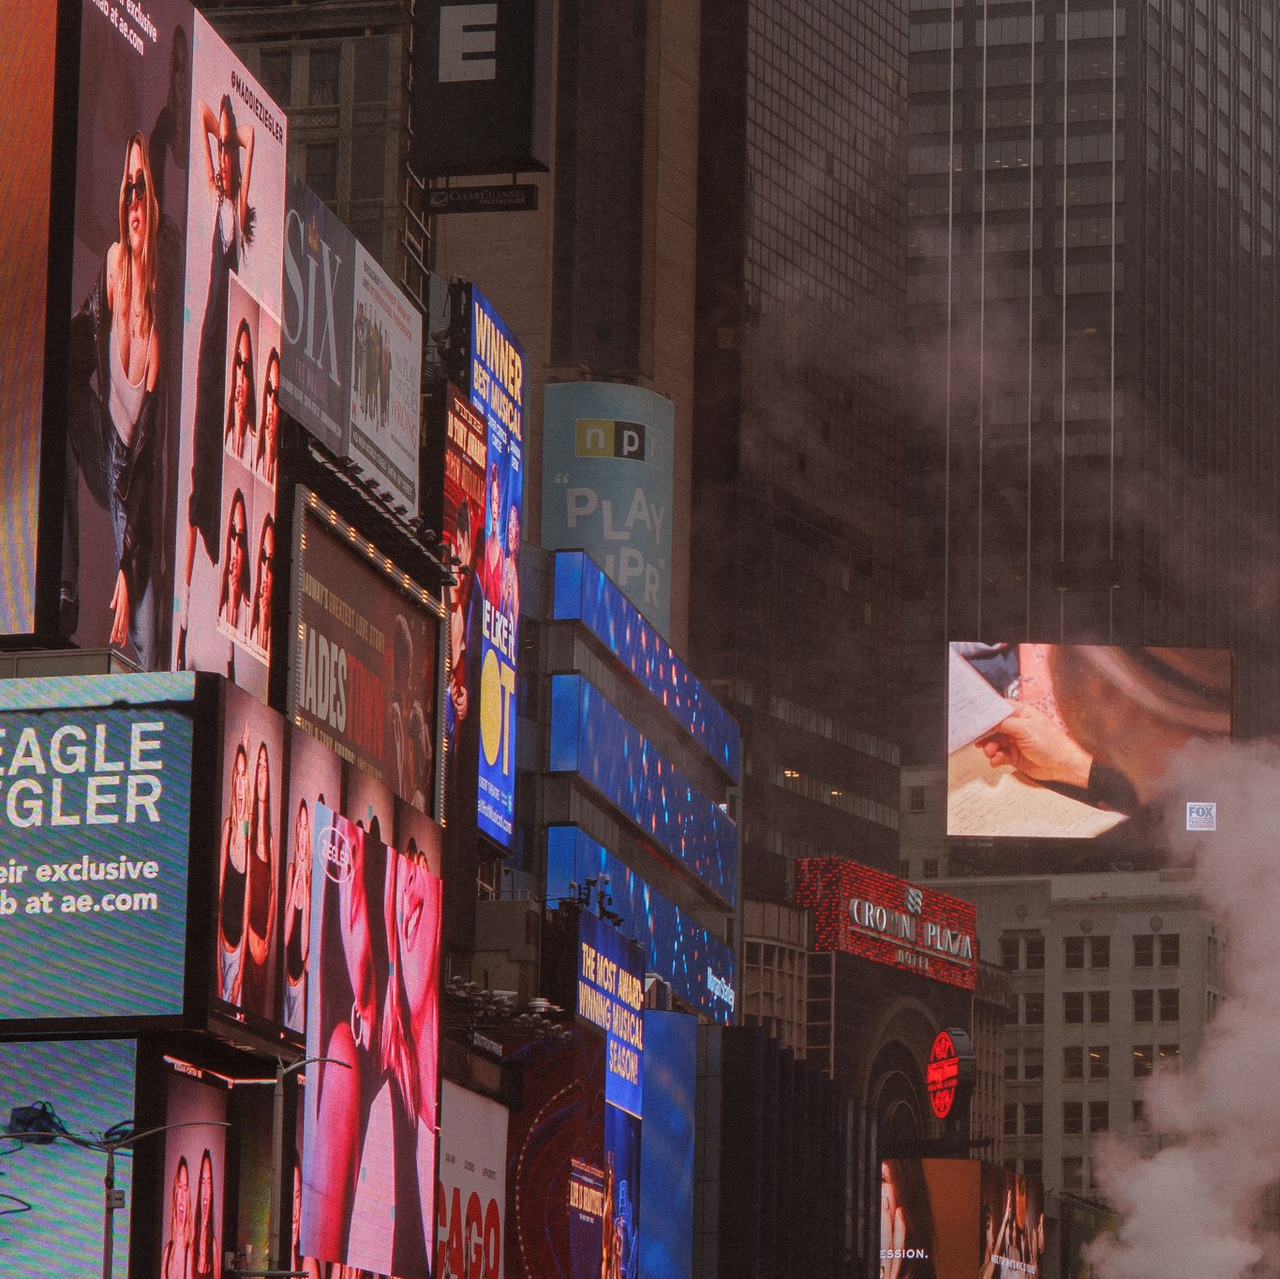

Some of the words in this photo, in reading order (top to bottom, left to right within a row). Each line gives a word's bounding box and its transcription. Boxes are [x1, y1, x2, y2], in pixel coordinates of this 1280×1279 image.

[110, 8, 118, 28] at
[119, 21, 144, 56] ae.com
[284, 209, 341, 388] SIX
[474, 298, 523, 415] WINNER
[473, 353, 489, 409] BEST
[490, 372, 522, 452] MUSICAL
[0, 775, 163, 828] GLER
[1189, 807, 1214, 817] FOX
[35, 854, 159, 882] exclusive
[25, 891, 53, 914] at
[61, 892, 158, 912] ae.com
[924, 923, 972, 960] PLAZA
[582, 942, 595, 979] THE
[597, 953, 617, 995] MOST
[579, 981, 611, 1031] WINNING
[612, 1002, 643, 1051] MUSICAL
